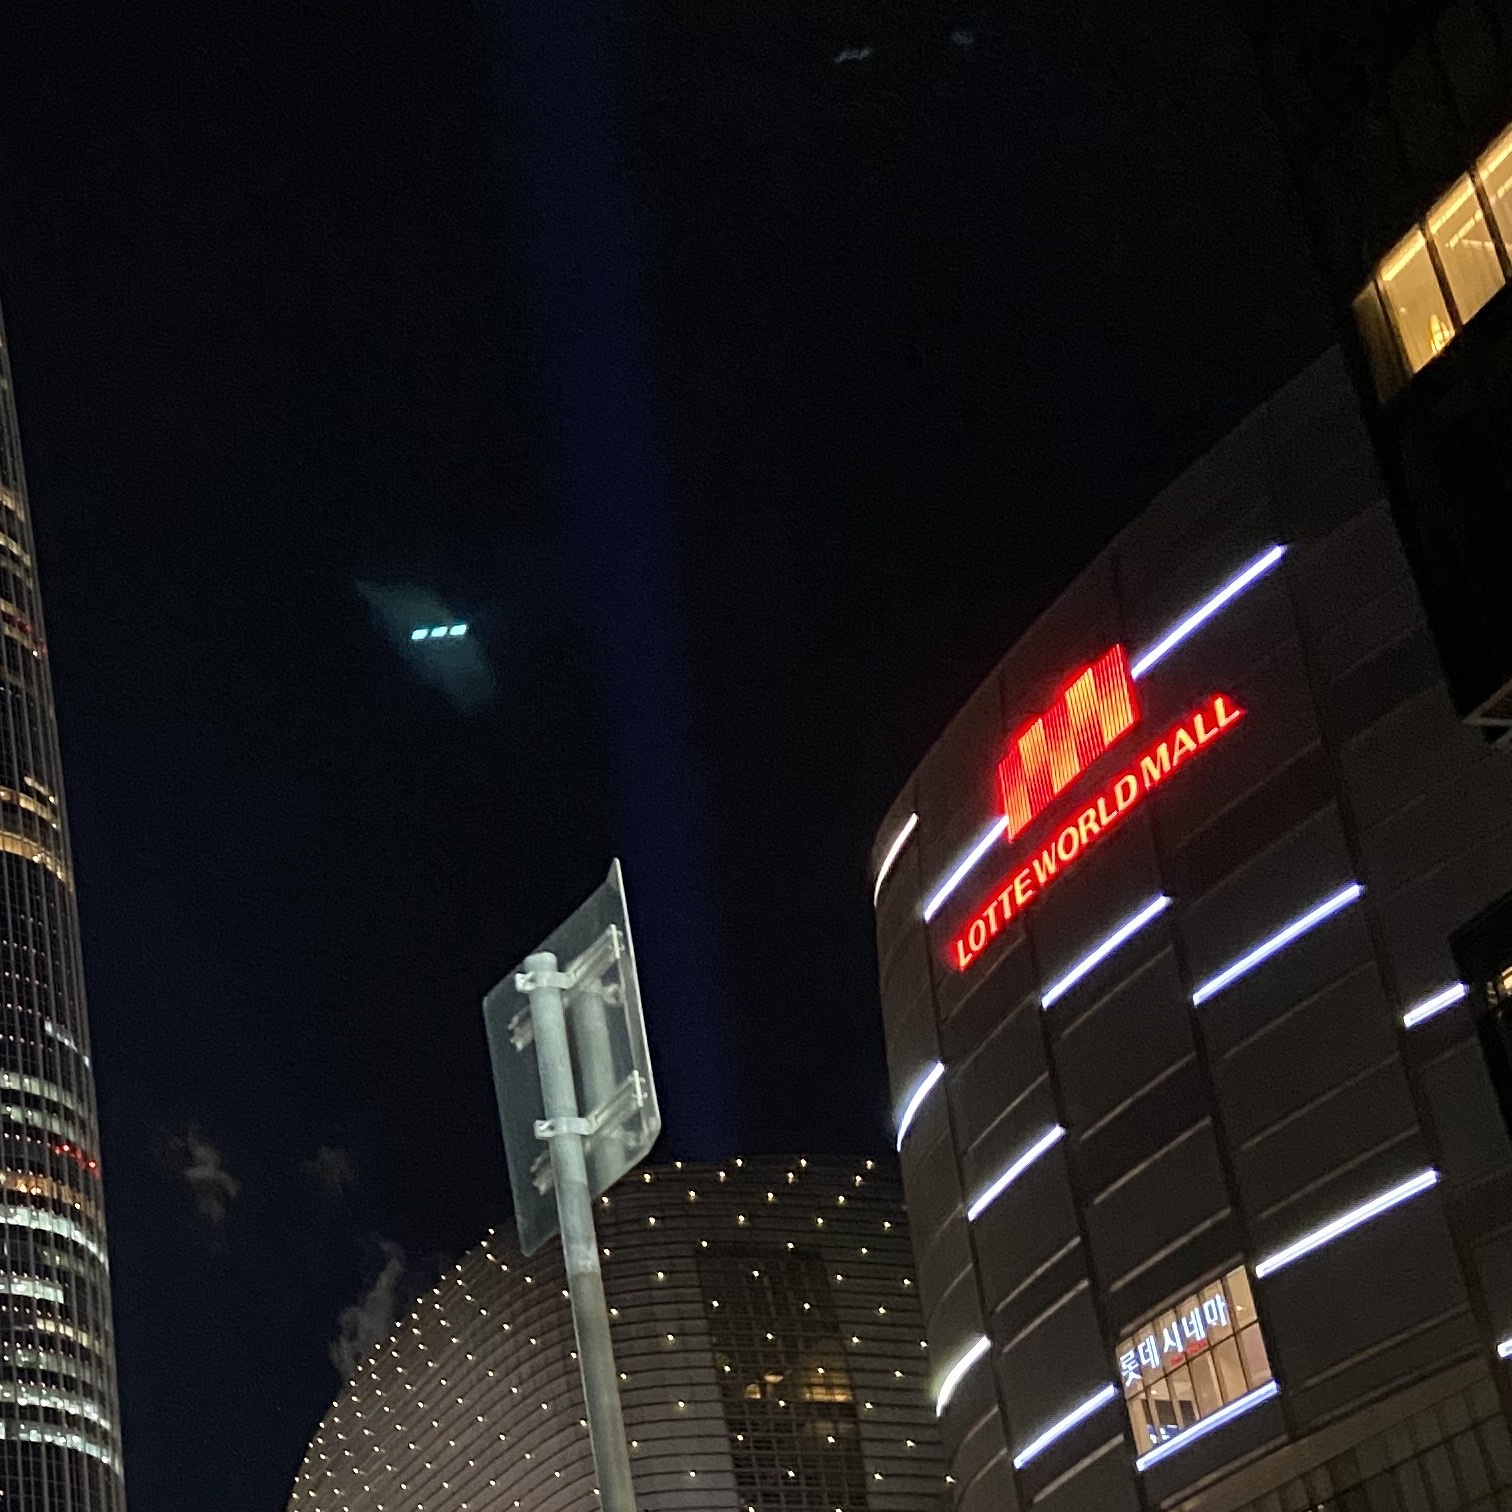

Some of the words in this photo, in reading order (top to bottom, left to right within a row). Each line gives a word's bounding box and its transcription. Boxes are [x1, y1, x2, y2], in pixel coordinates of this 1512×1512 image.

[955, 867, 1036, 969] LOTTE
[1032, 773, 1139, 885] WORLD
[1139, 696, 1242, 790] MALL
